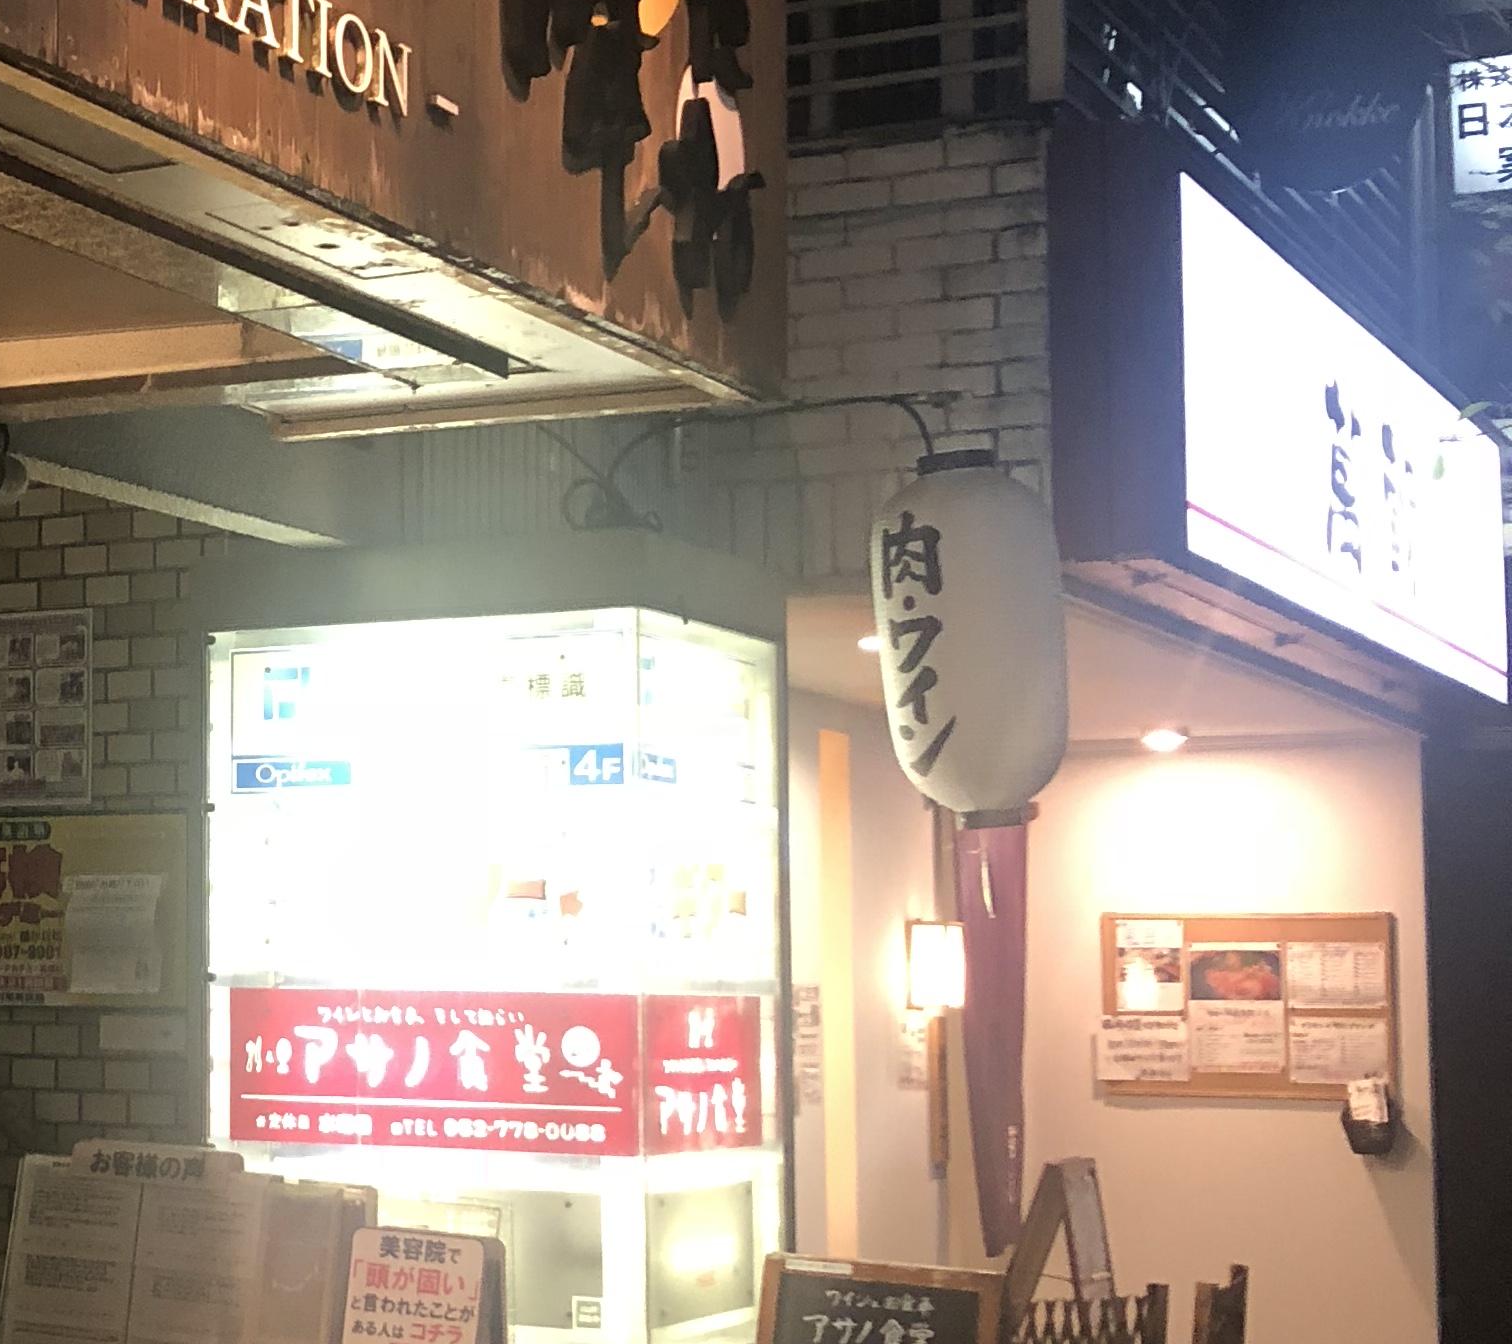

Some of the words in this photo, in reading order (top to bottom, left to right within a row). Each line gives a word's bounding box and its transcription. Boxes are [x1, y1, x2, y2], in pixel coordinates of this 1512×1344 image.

[879, 511, 958, 779] 肉・ワイン
[573, 749, 621, 782] 4F
[293, 1023, 551, 1093] アサノ食堂
[379, 1235, 462, 1265] 美容院で
[352, 1258, 480, 1302] 「頭が固い」
[350, 1293, 475, 1324] と言われたことが
[351, 1319, 404, 1339] ある人は
[410, 1322, 463, 1344] コチラ
